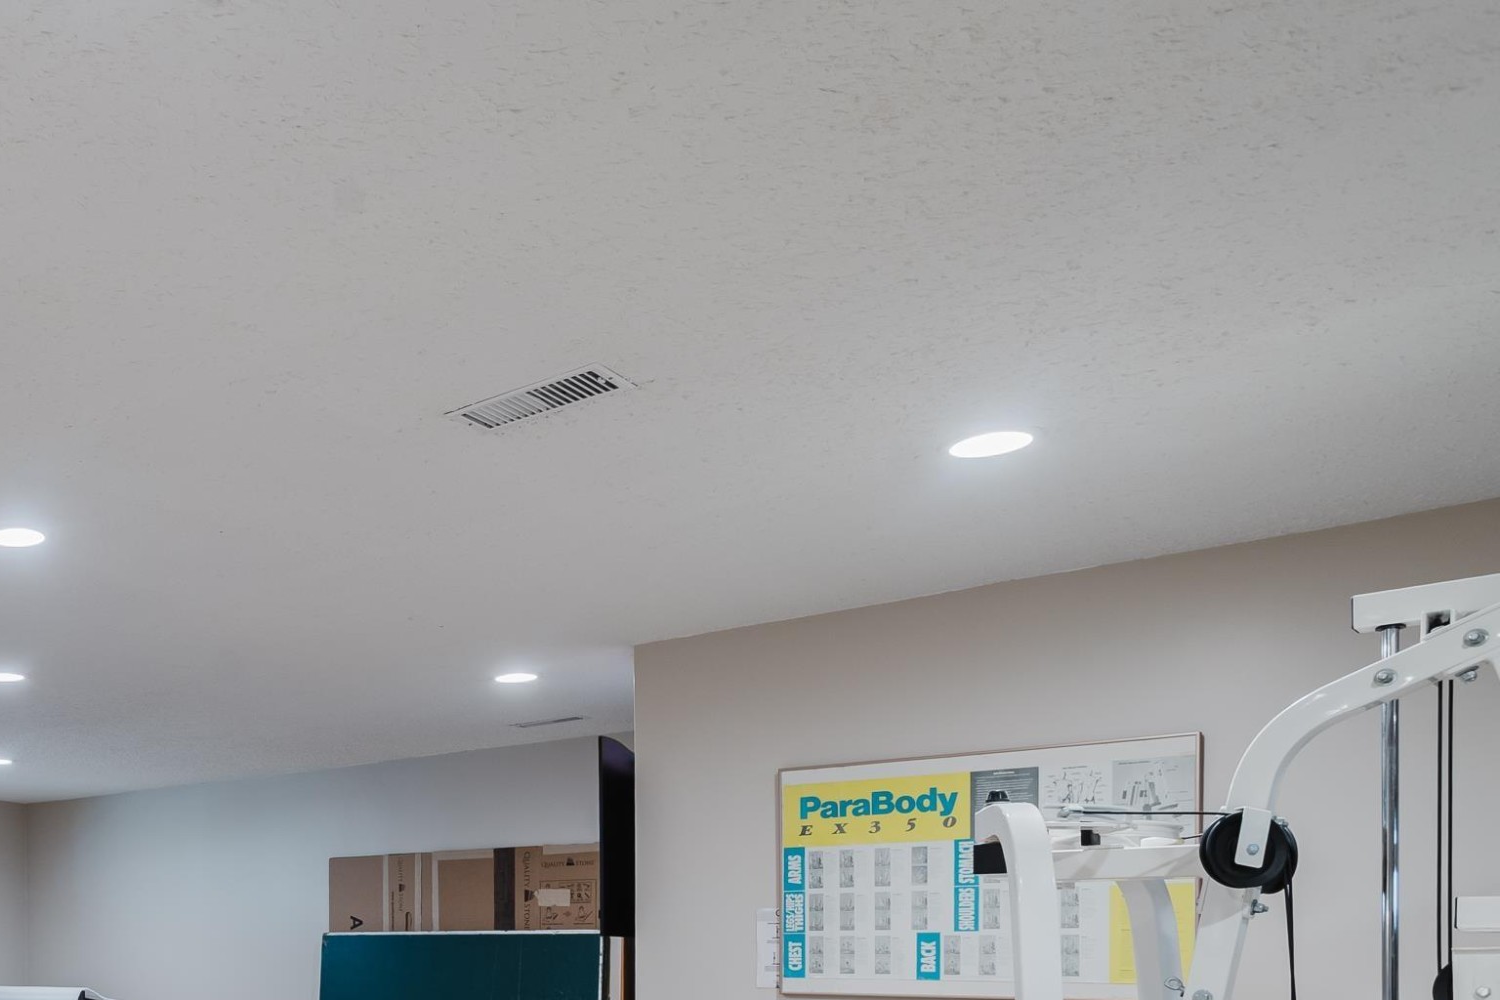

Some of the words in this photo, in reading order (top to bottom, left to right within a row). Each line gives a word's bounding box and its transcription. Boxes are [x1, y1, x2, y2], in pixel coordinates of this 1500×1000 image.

[799, 787, 958, 820] ParaBody
[522, 851, 531, 888] QUALITY
[540, 859, 565, 869] QUALITY
[787, 854, 802, 885] ARMS
[958, 840, 975, 884] STOMACH
[794, 893, 804, 932] THIGHS
[958, 887, 976, 931] SHOULDERS
[788, 941, 803, 971] CHEST
[920, 940, 937, 973] BACK
